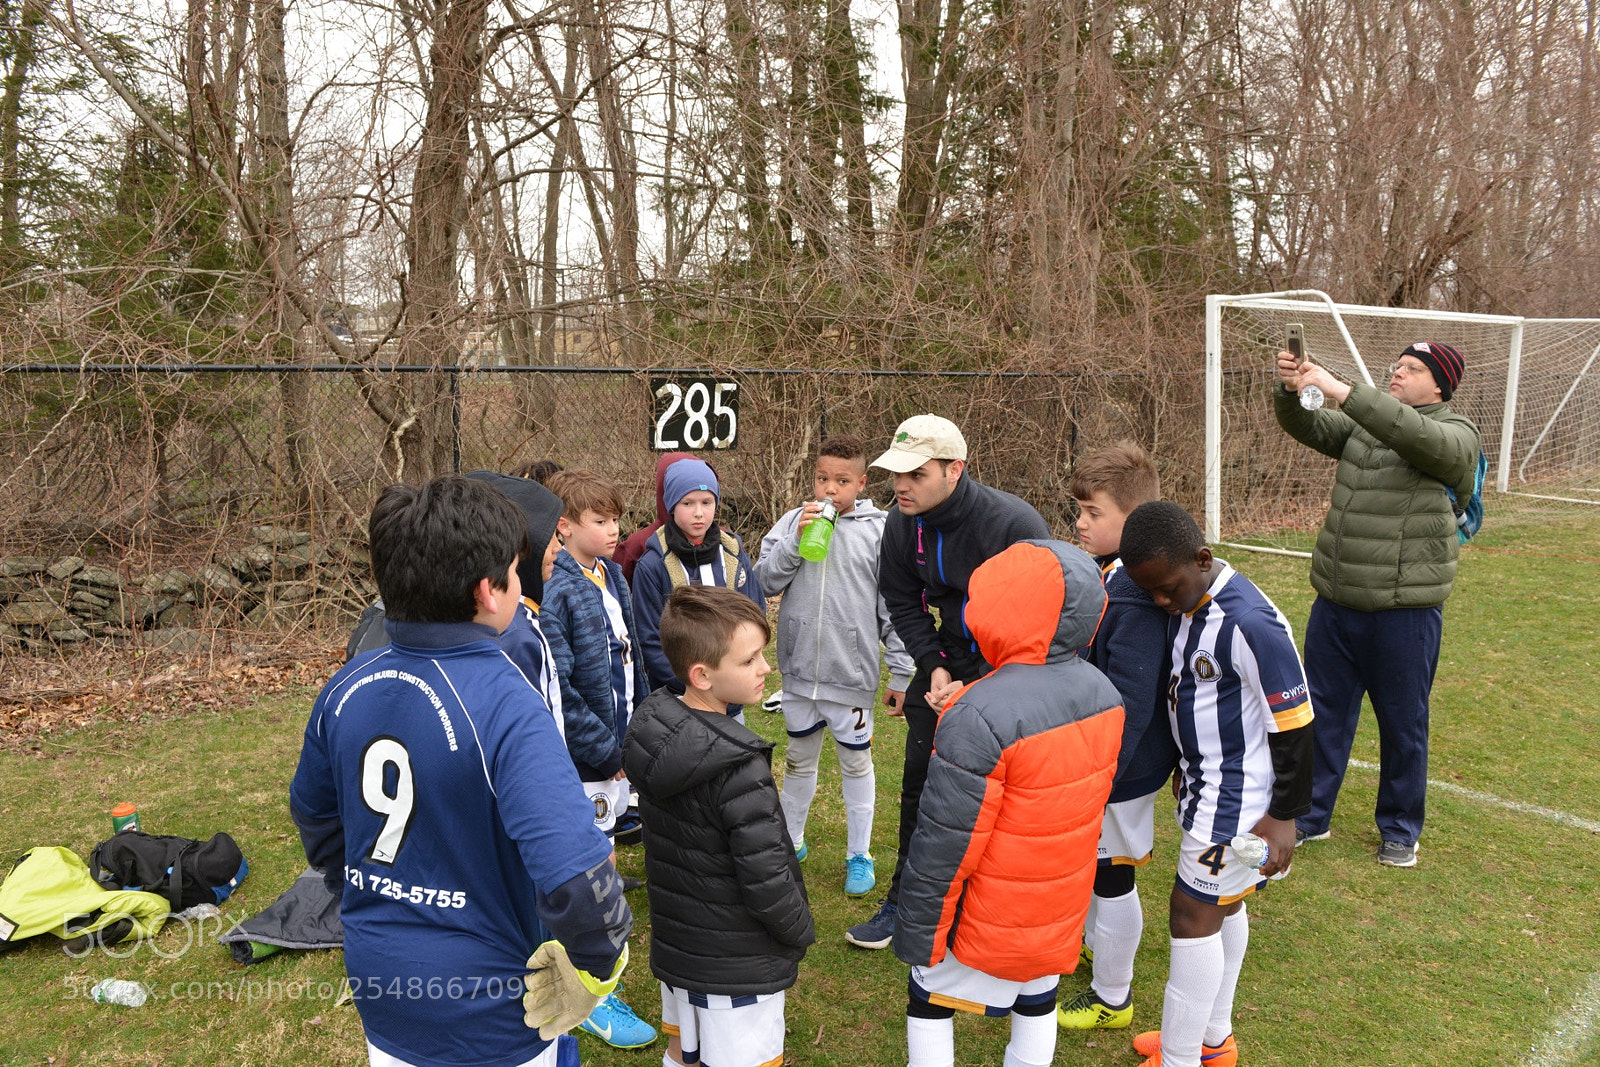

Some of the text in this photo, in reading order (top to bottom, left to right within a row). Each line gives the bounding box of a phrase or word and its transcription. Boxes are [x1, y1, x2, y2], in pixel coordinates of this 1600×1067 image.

[654, 382, 737, 449] 285
[334, 669, 458, 752] REPRESENTING INJURED CONSTRUCTION WORKERS
[851, 706, 866, 731] 2
[359, 735, 415, 867] 9
[1197, 844, 1227, 876] 4
[368, 874, 467, 909] 725-5755
